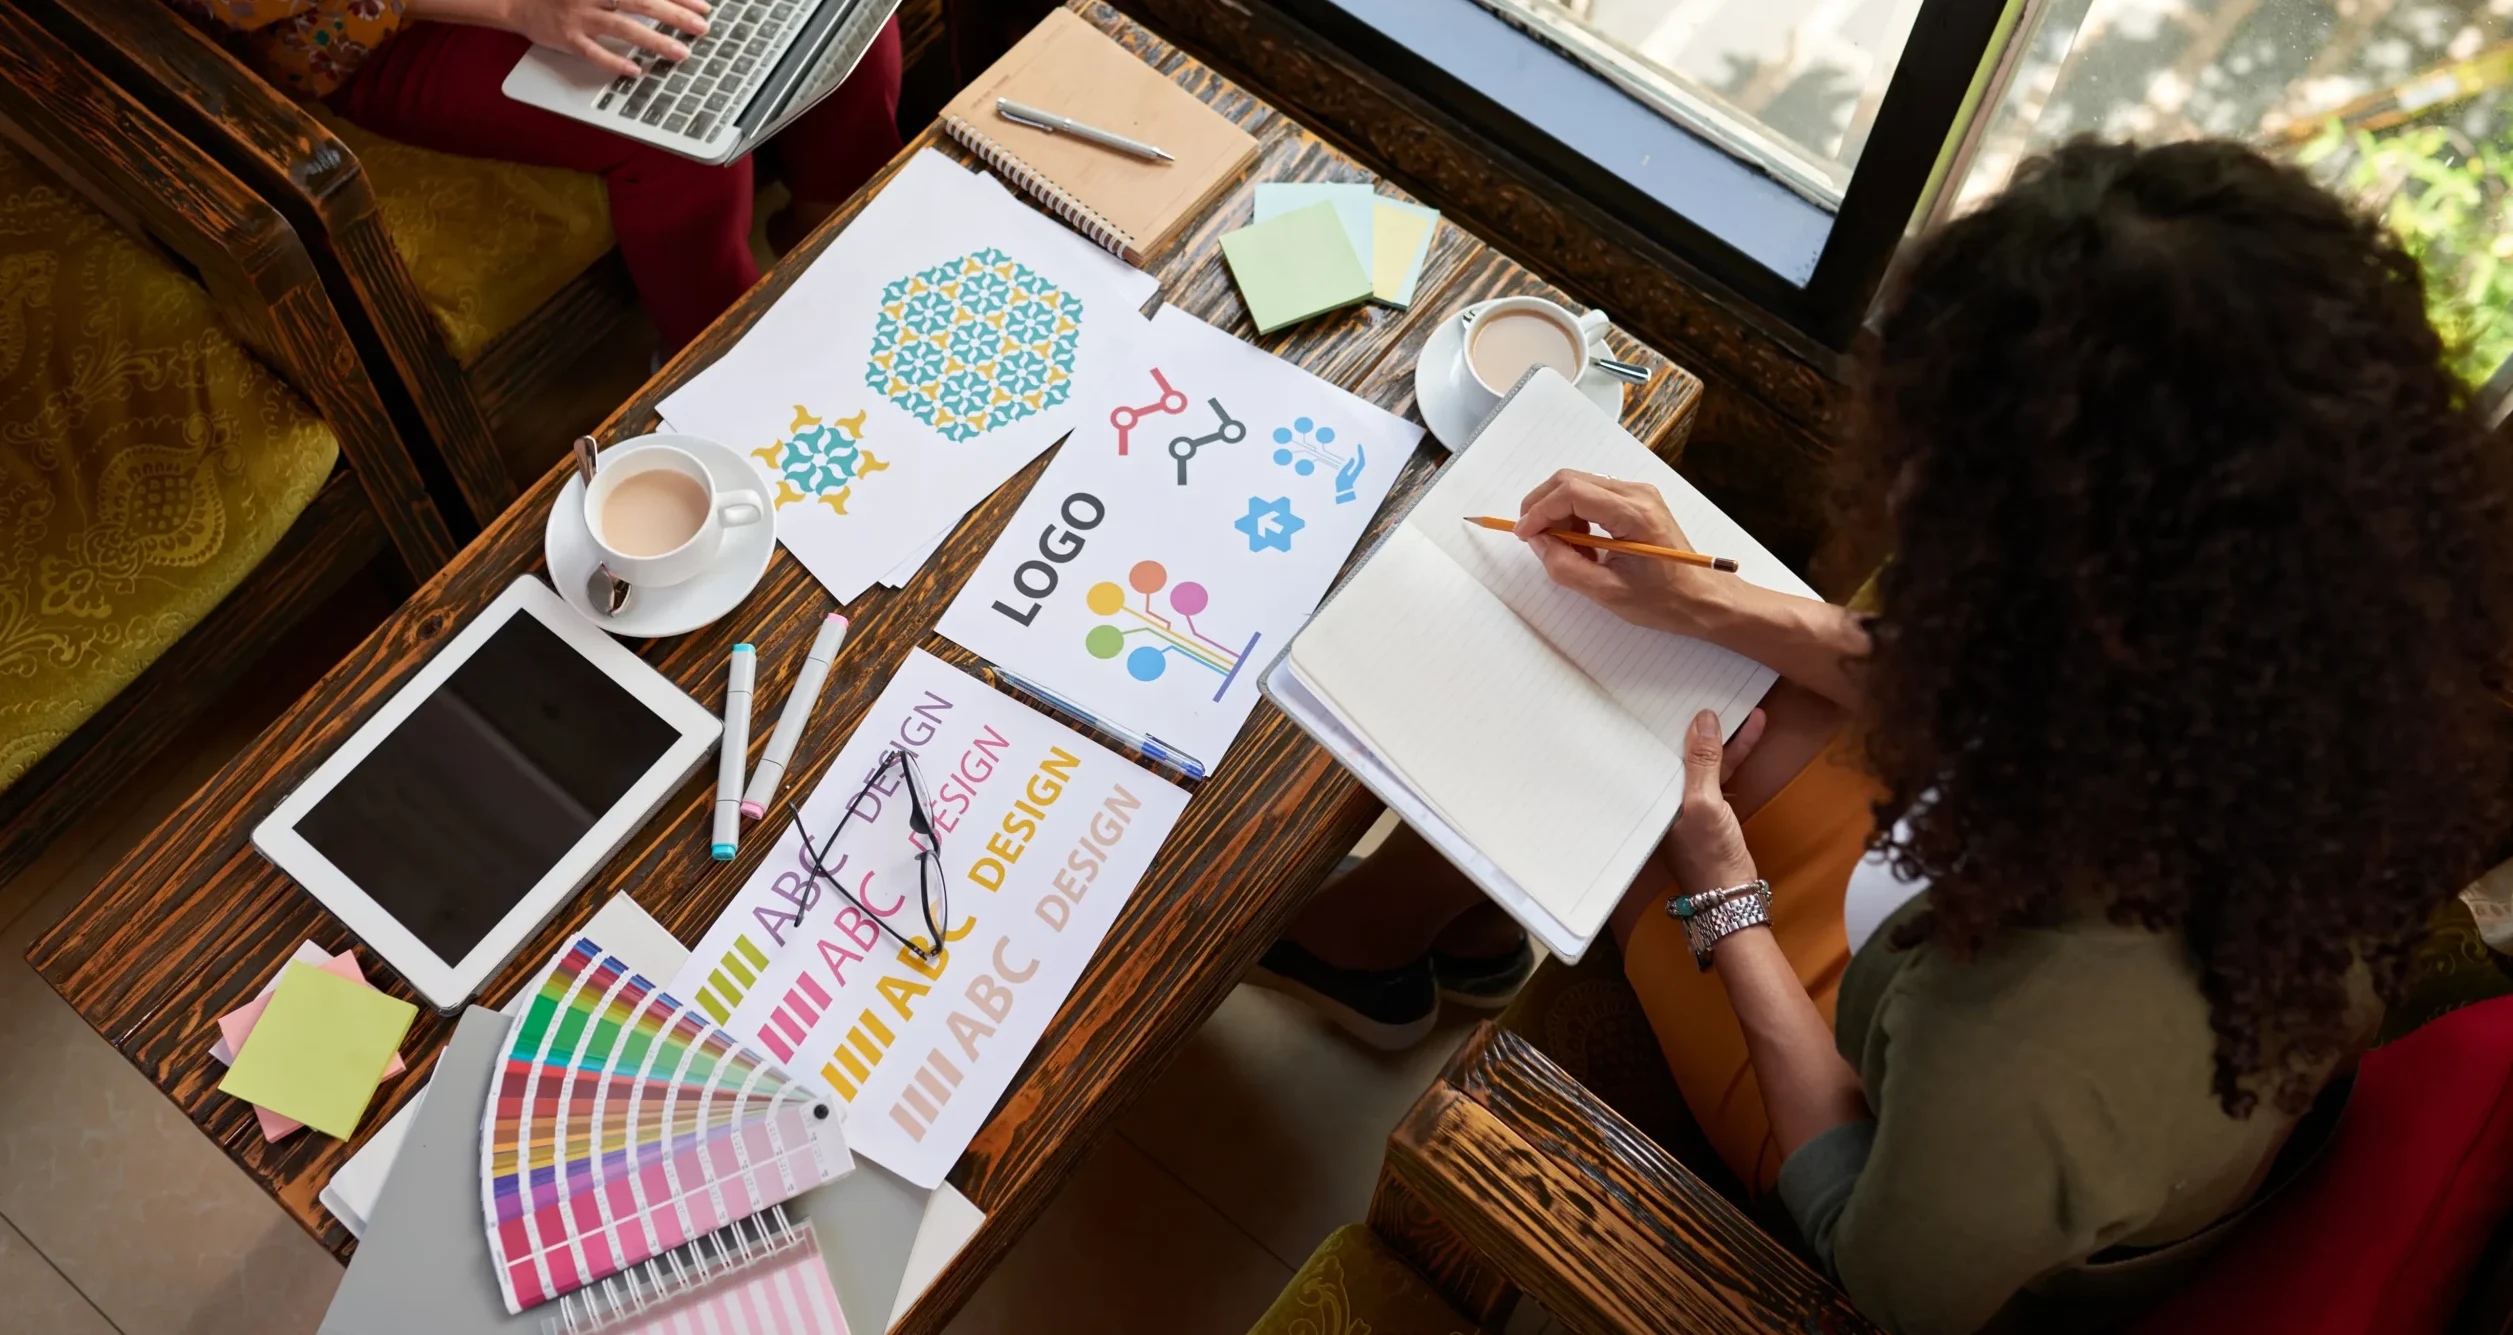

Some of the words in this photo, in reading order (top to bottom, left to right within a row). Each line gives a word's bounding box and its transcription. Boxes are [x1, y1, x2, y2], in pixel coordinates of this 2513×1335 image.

[991, 492, 1106, 628] LOGO
[752, 834, 849, 948] ABC
[816, 870, 906, 988] ABC
[875, 898, 978, 1023] ABC
[967, 745, 1082, 893] DESIGN
[945, 934, 1041, 1064] ABC
[1034, 783, 1143, 933] DESIGN
